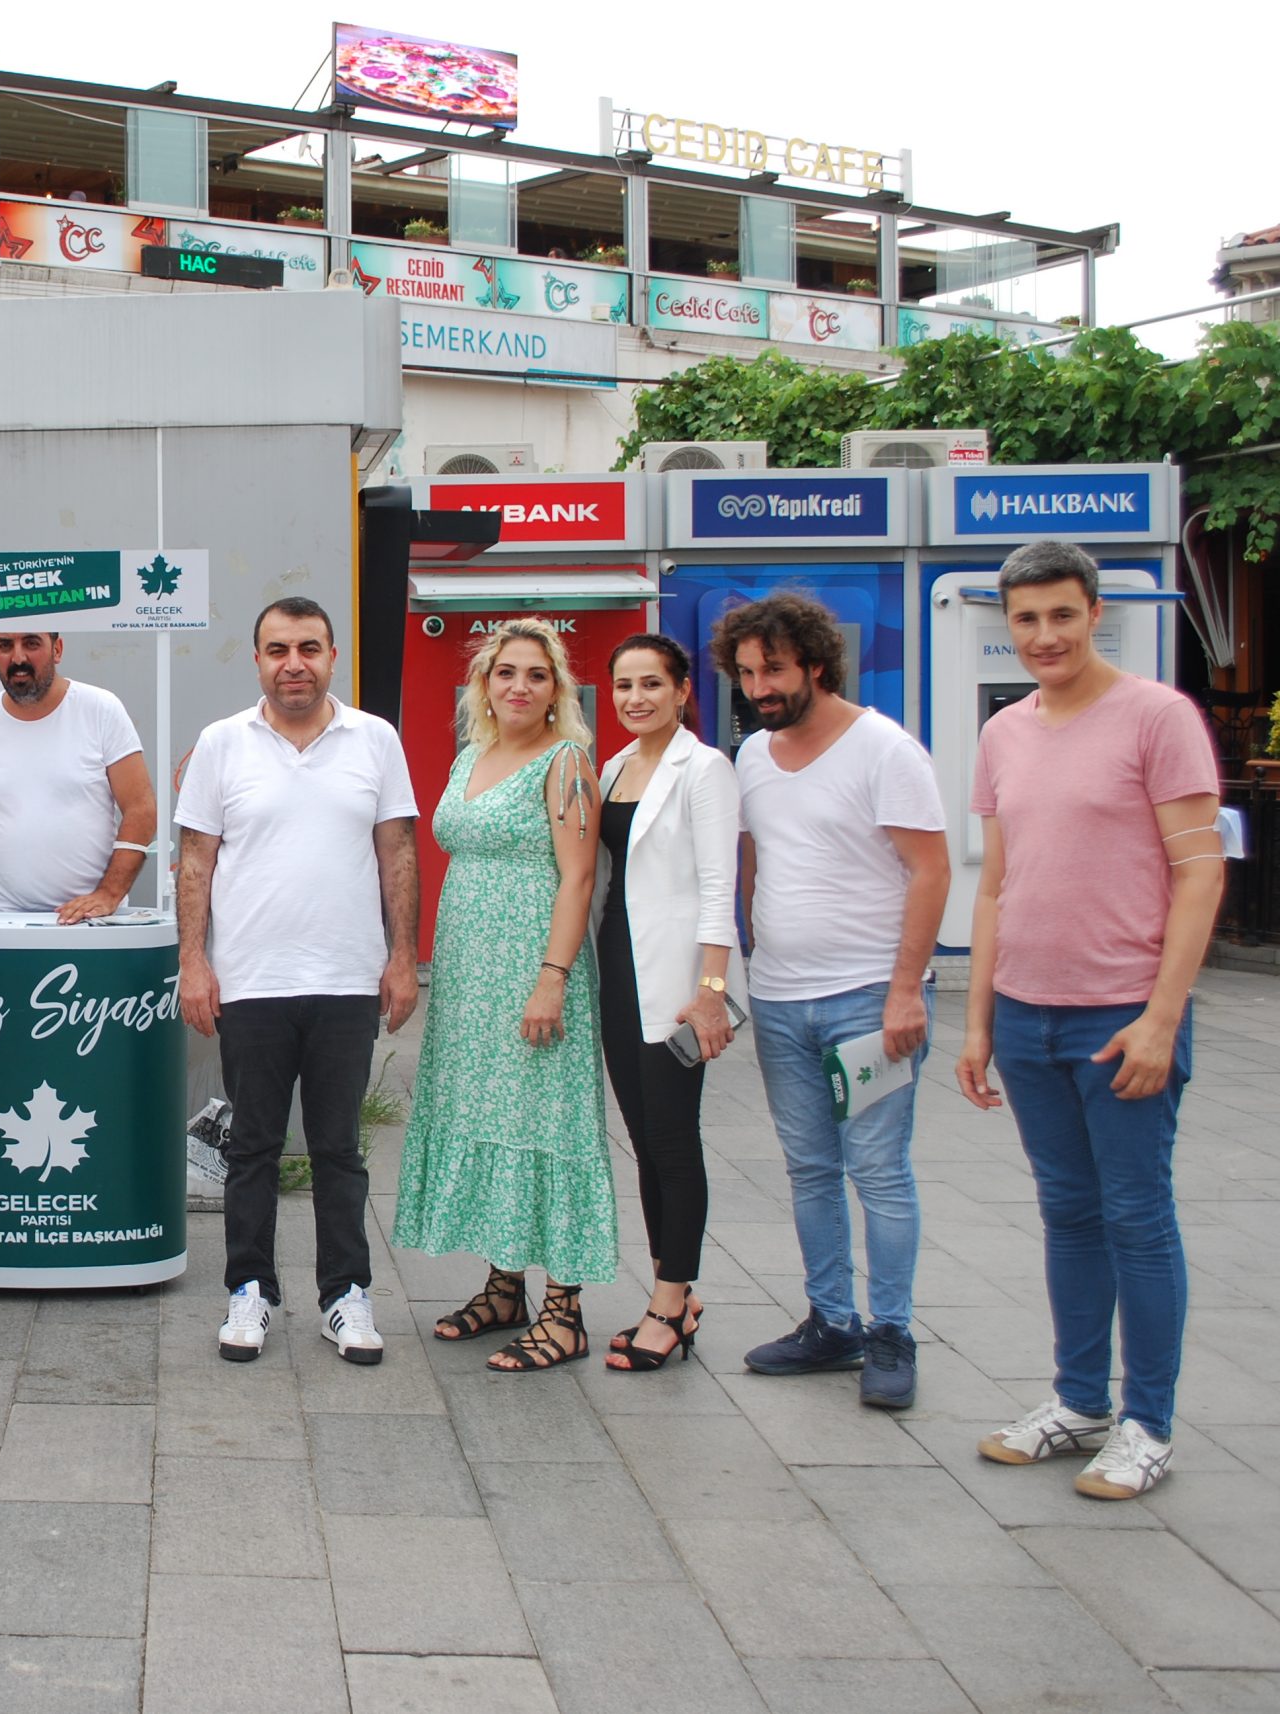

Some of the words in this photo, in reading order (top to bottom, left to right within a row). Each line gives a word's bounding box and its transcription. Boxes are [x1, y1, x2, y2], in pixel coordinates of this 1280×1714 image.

[642, 113, 768, 170] CEDID
[785, 137, 884, 188] CAFE
[179, 253, 217, 274] HAC
[386, 277, 465, 302] RESTAURANT
[655, 292, 711, 320] Cedid
[715, 299, 760, 324] Cafe
[1001, 492, 1136, 515] HALKBANK
[135, 606, 183, 614] GELECEK
[469, 619, 577, 633] AKNK
[30, 963, 182, 1057] Siyaset
[34, 1229, 69, 1245] İLÇE
[72, 1223, 163, 1244] BAŞKANLIĞI
